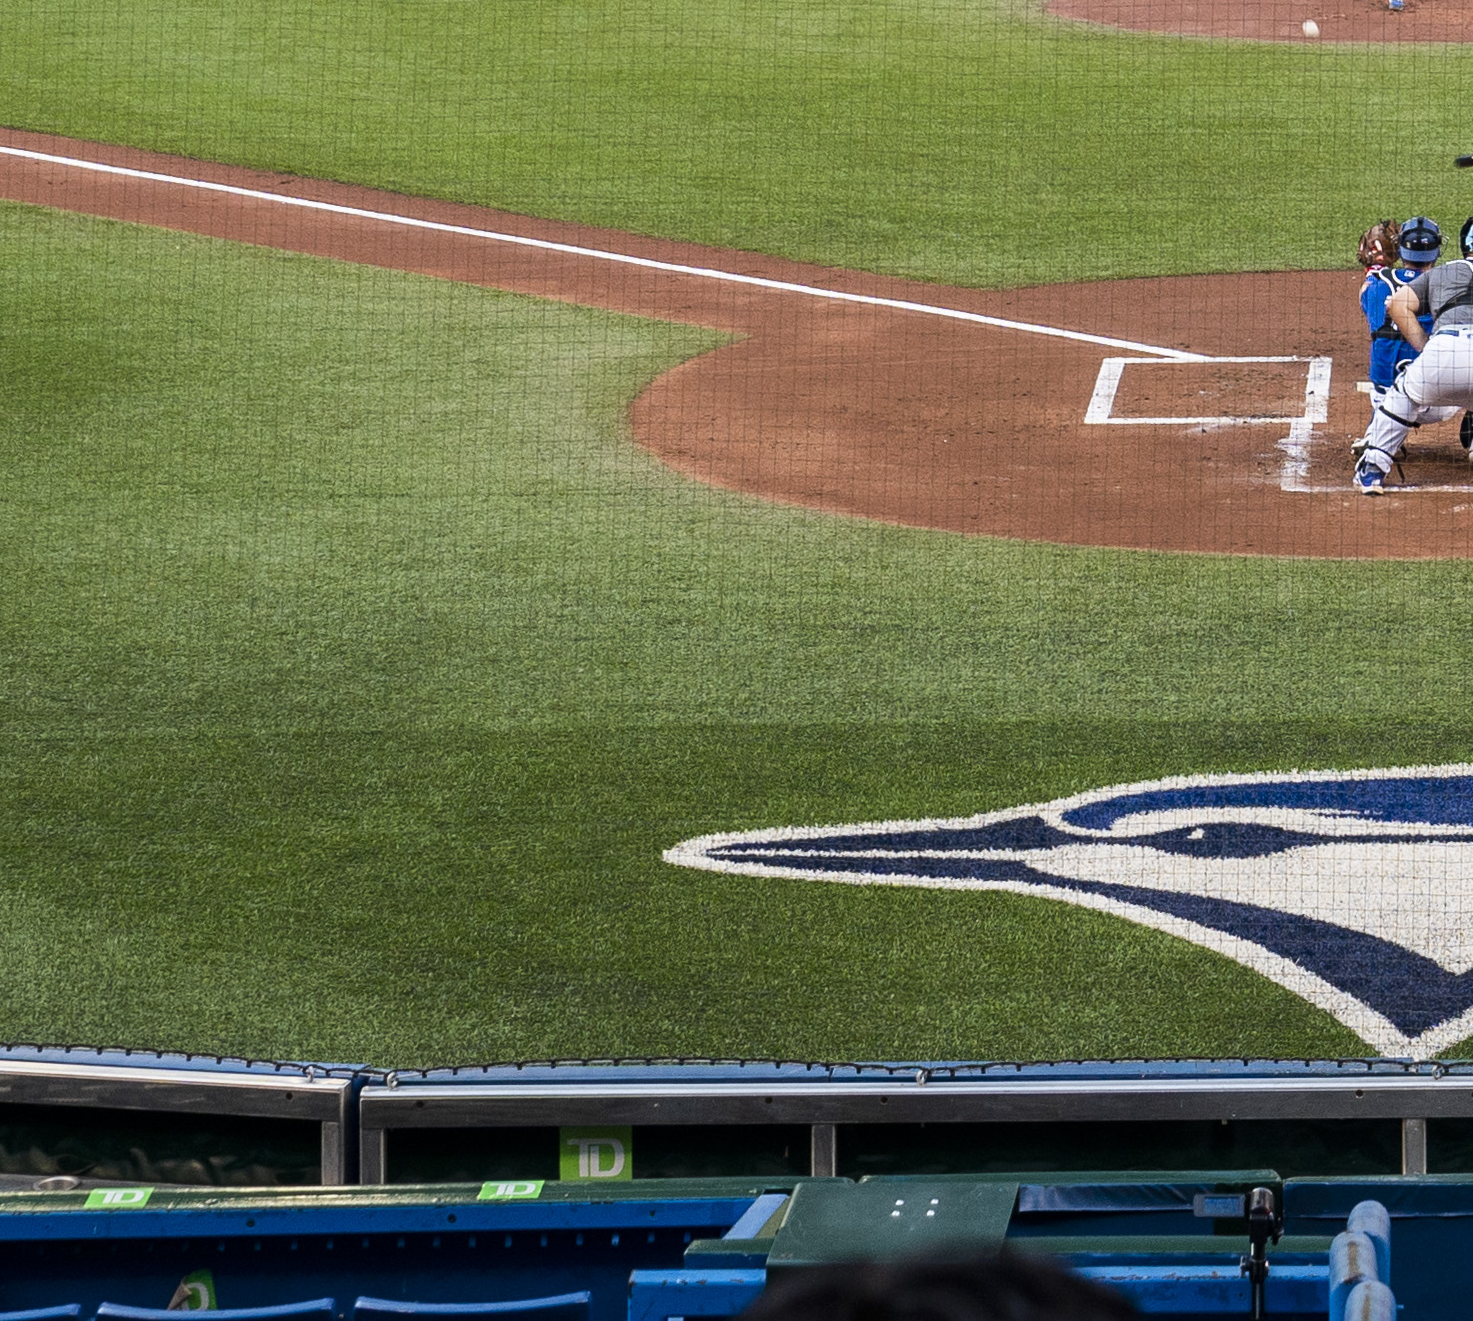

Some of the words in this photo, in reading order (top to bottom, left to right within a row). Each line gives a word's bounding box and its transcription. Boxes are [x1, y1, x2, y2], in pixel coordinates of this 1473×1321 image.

[566, 1137, 625, 1178] TD
[96, 1189, 145, 1206] TD
[488, 1182, 535, 1197] TD
